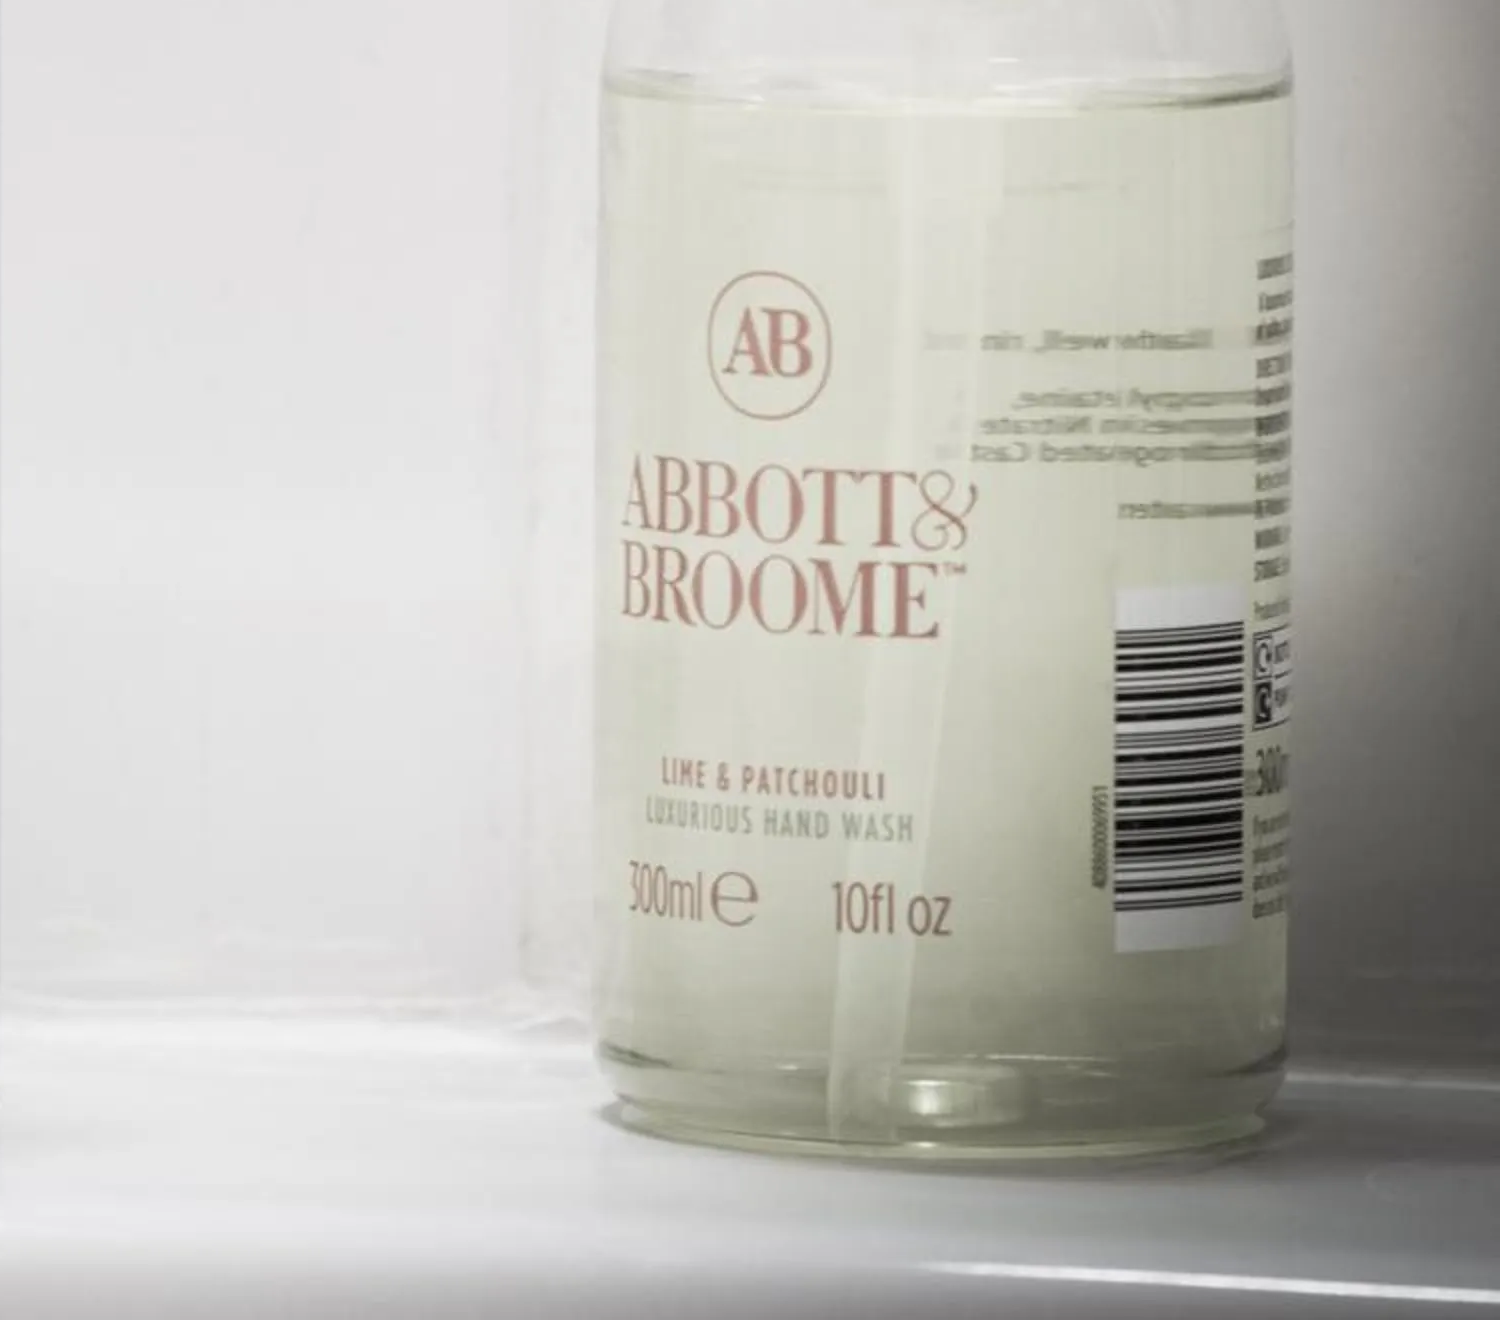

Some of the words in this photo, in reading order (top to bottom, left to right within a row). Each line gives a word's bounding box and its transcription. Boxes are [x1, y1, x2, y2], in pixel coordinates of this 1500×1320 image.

[720, 306, 813, 378] AB
[621, 539, 940, 639] BROOME
[661, 756, 707, 789] LIME
[716, 762, 730, 792] &
[741, 765, 885, 801] PATCHOULI
[645, 795, 753, 835] LUXURIOUS
[763, 808, 830, 839] HAND
[841, 812, 914, 842] WASH
[629, 860, 704, 922] 300ml
[830, 881, 896, 935] 10fl
[906, 895, 953, 937] oz
